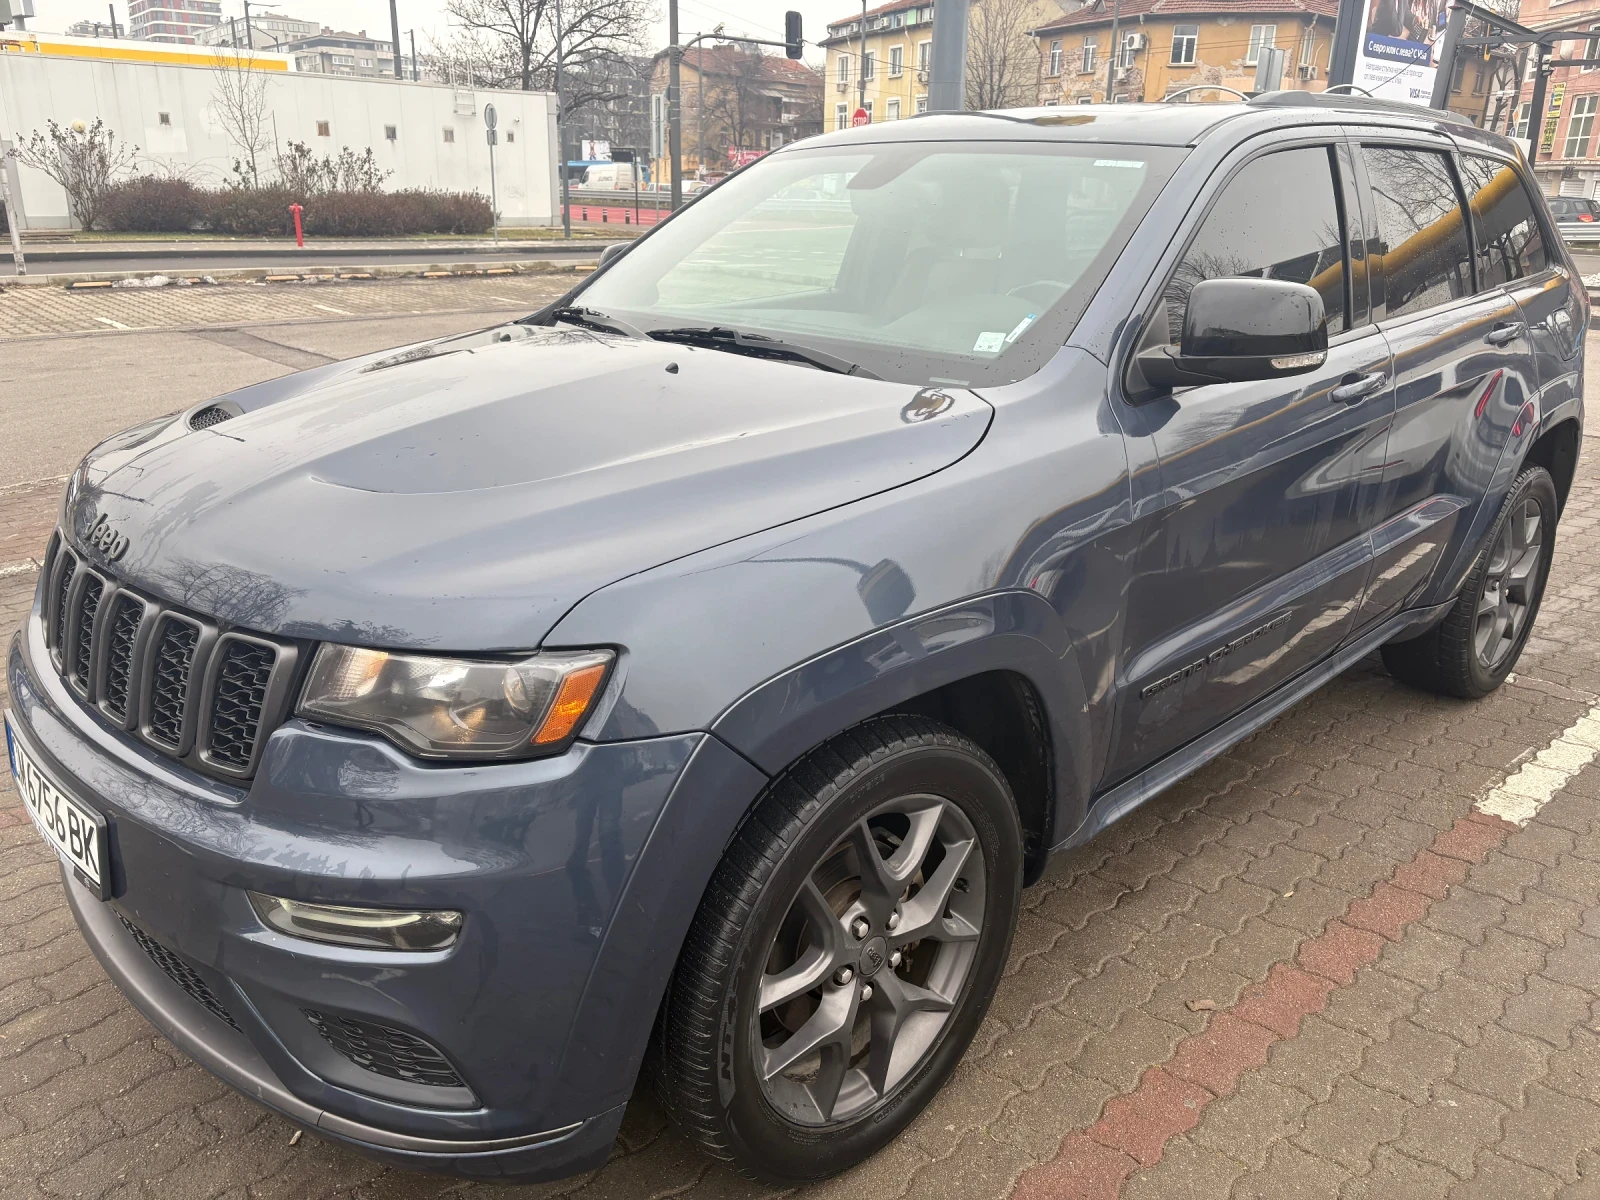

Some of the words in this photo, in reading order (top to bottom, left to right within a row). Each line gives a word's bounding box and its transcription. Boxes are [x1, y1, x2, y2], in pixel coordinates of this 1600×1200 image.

[1373, 44, 1386, 54] евро
[1409, 88, 1420, 98] VISA
[853, 117, 867, 127] STOP
[85, 513, 130, 566] Jeep
[1139, 658, 1205, 700] GRAND
[1206, 611, 1292, 664] CHEROKEE
